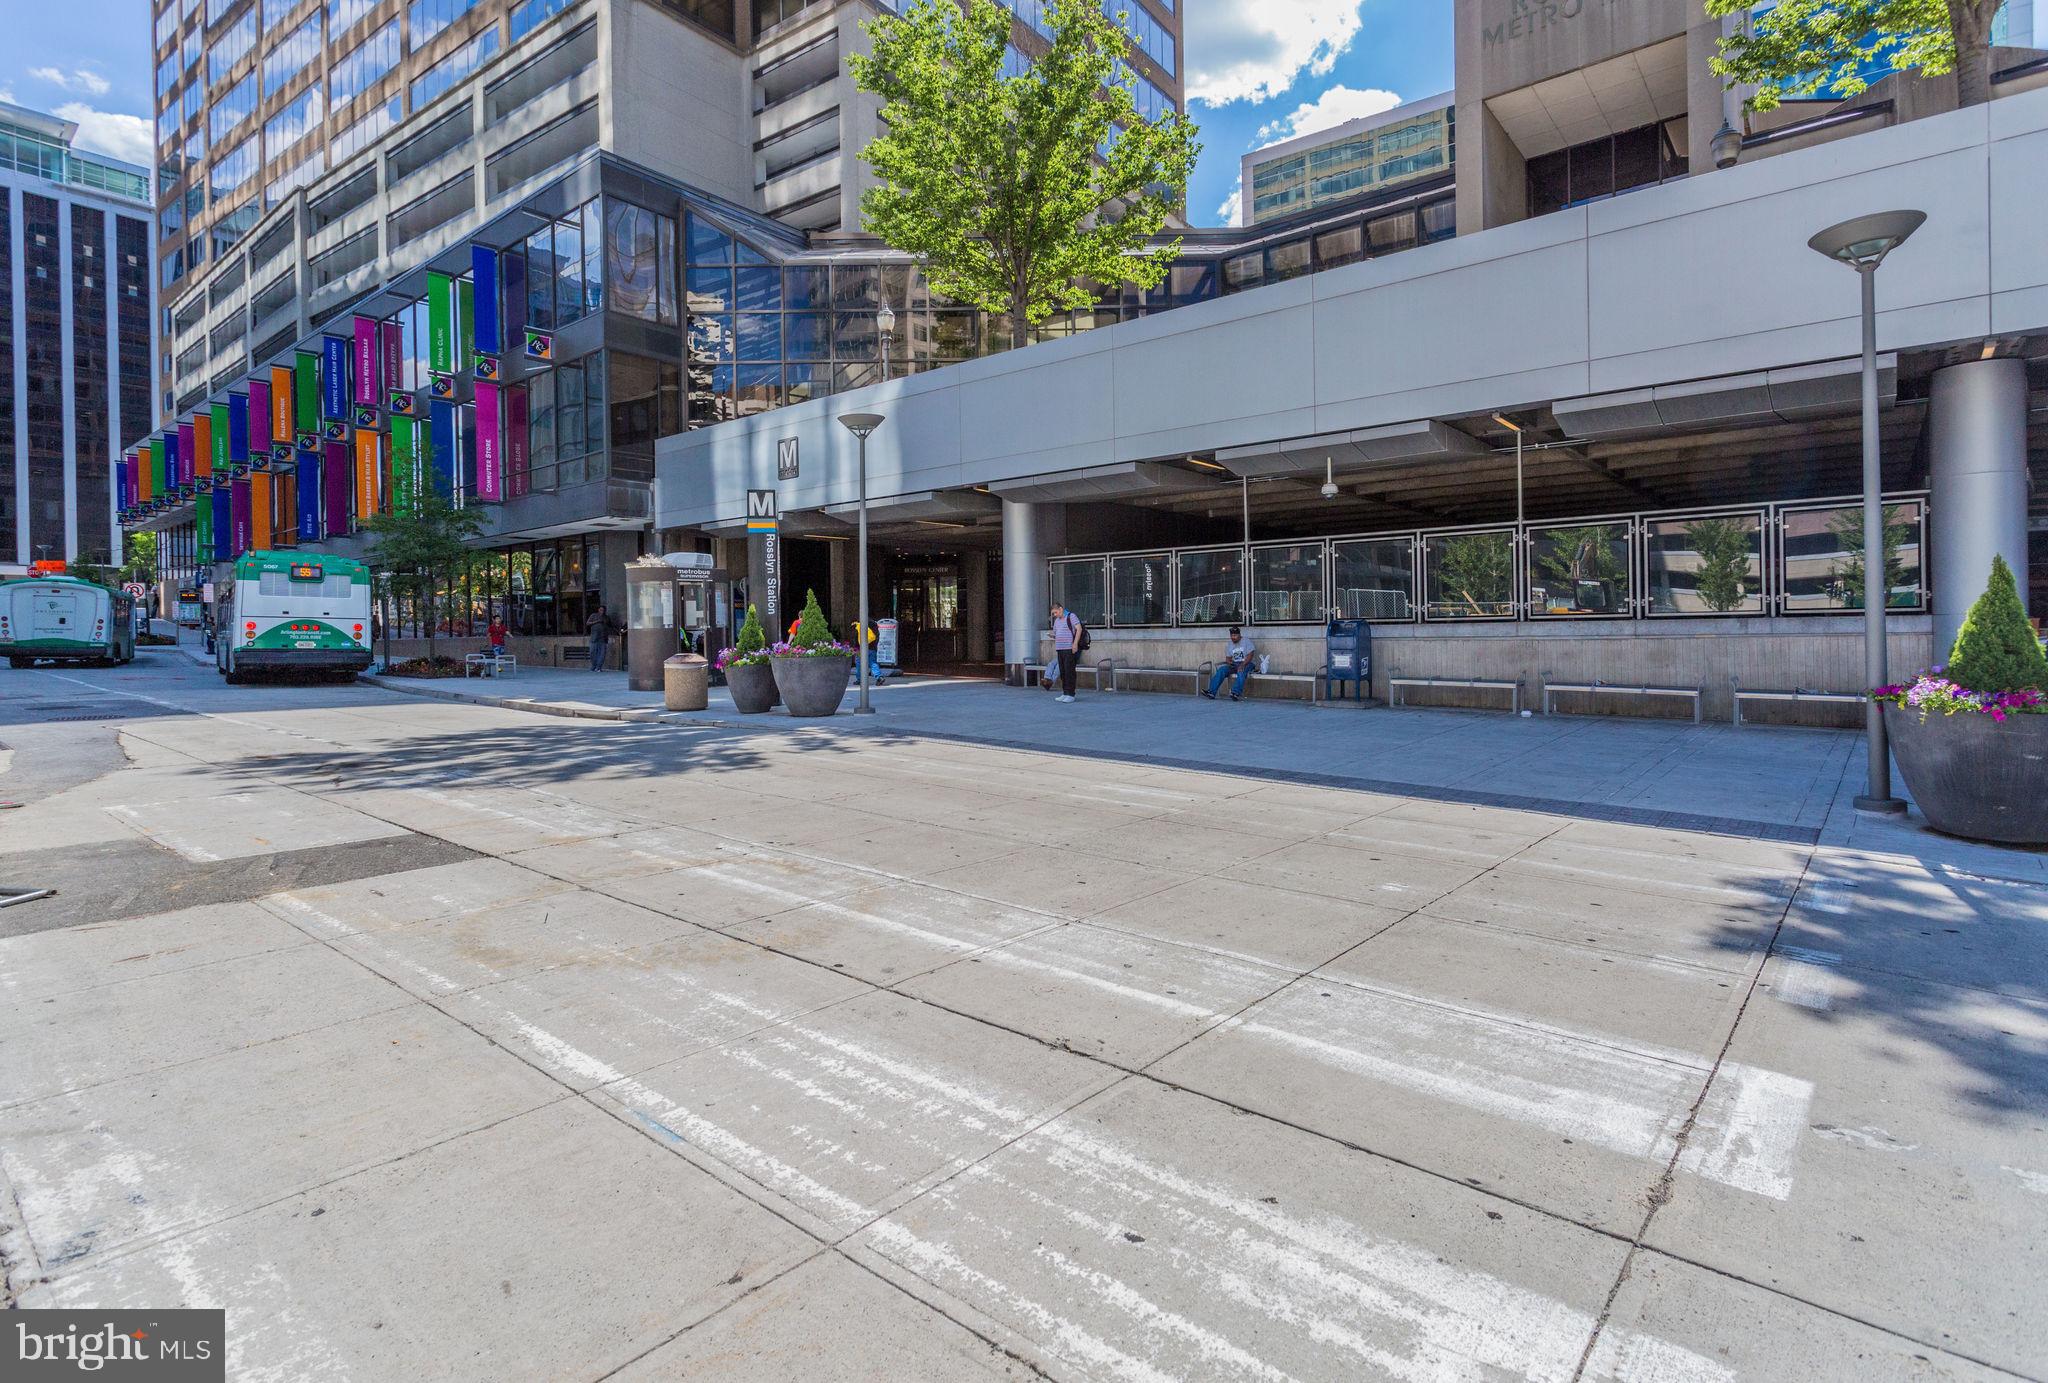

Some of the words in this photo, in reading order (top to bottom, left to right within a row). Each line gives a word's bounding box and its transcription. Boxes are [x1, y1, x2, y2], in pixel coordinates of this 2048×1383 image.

[779, 440, 797, 468] M
[748, 492, 774, 516] M
[766, 534, 776, 574] Rosslyn
[300, 567, 312, 576] 55
[767, 578, 777, 615] Station
